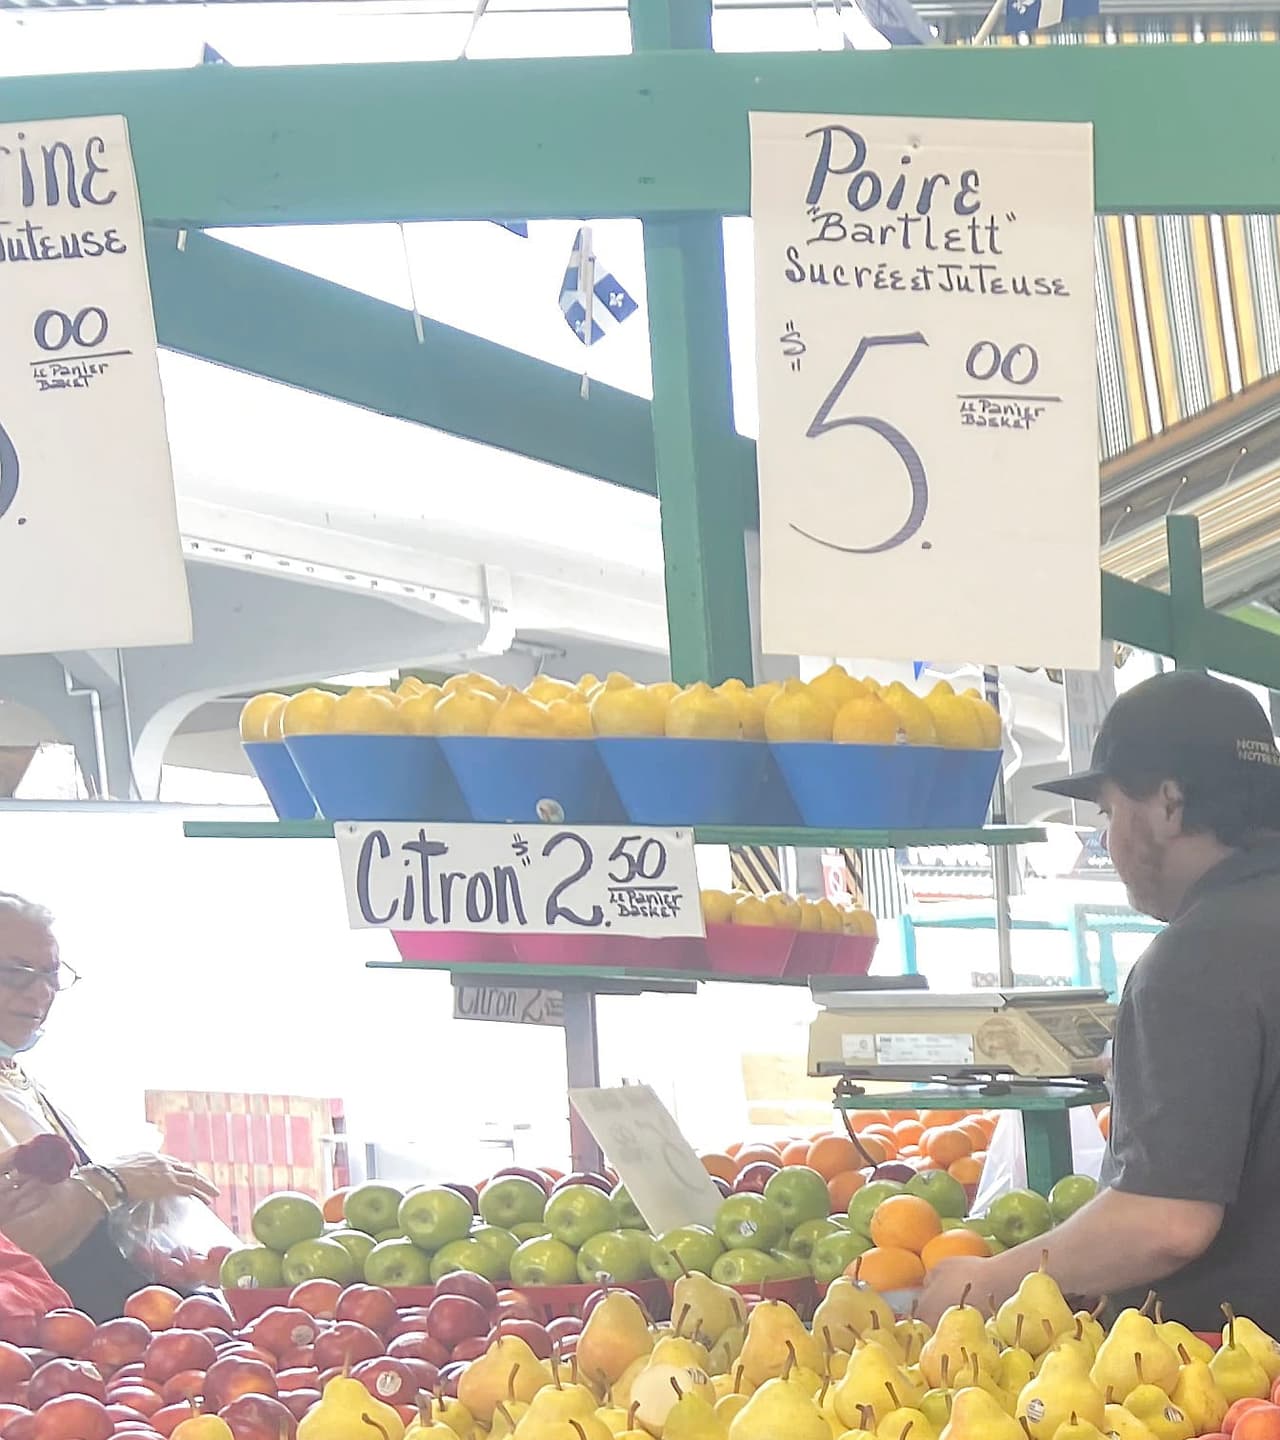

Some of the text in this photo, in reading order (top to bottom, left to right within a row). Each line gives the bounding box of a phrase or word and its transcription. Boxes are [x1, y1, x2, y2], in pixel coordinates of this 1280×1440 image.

[0, 132, 117, 208] ine
[805, 125, 982, 215] Poire
[785, 247, 905, 290] Sucrée
[909, 263, 935, 292] et
[34, 307, 109, 351] 00
[965, 341, 1039, 385] 00
[356, 828, 528, 925] Citron
[608, 836, 667, 883] 50
